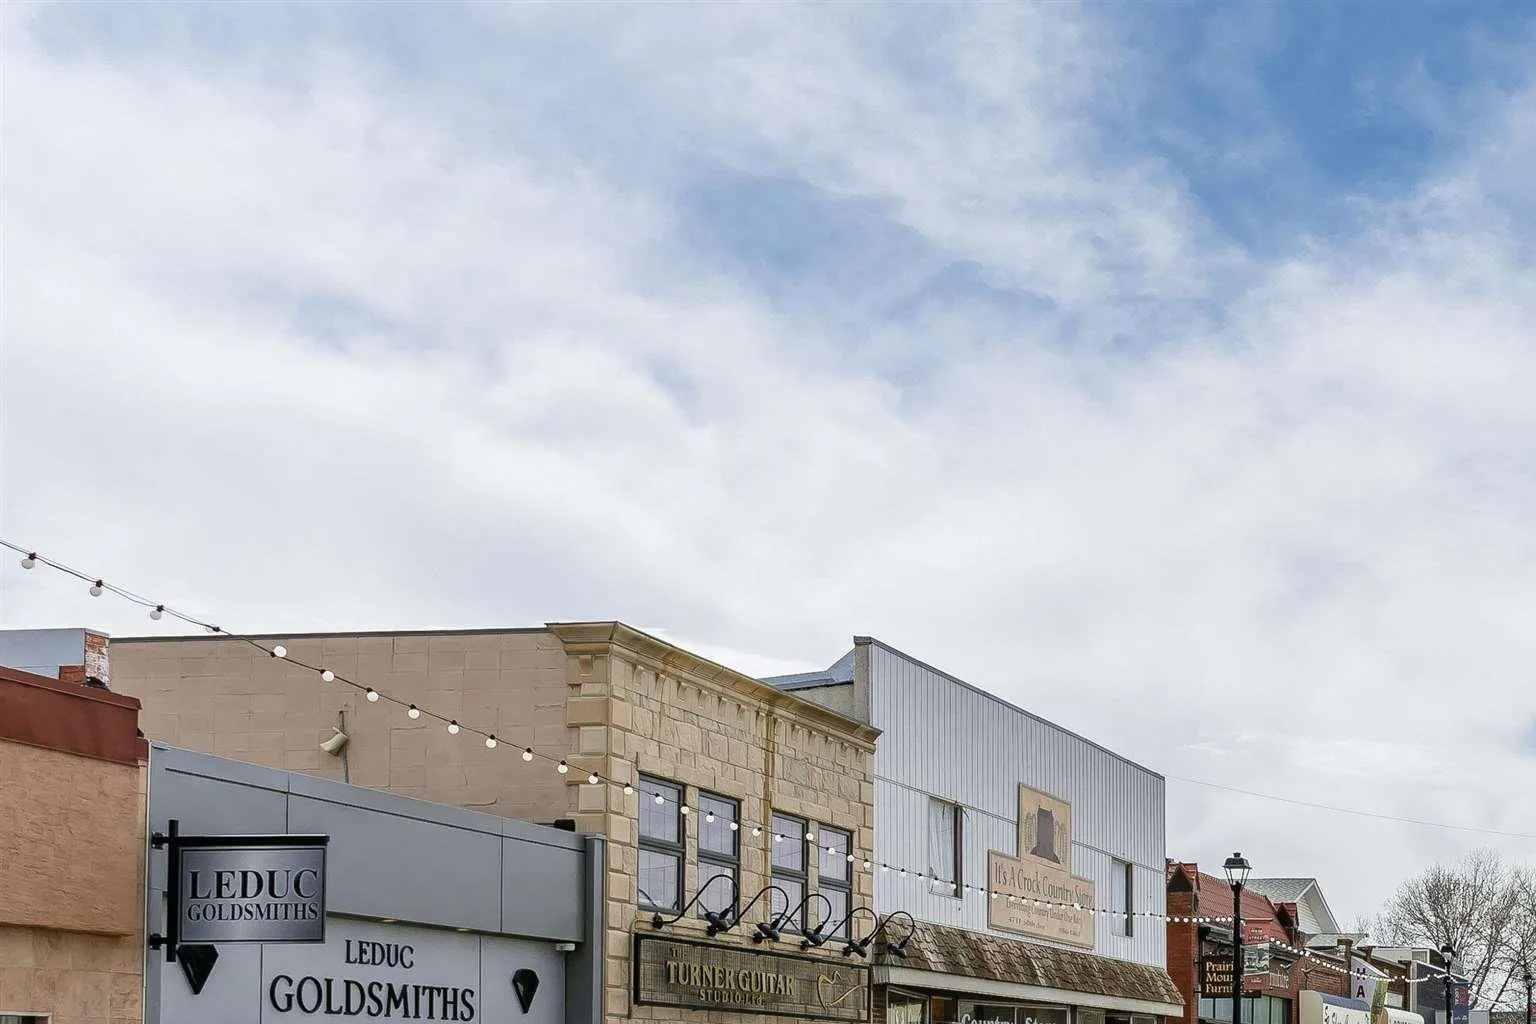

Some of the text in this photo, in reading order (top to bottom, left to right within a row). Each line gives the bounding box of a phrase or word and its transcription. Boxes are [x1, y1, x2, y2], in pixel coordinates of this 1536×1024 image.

[188, 868, 318, 900] LEDUC
[994, 861, 1007, 886] It's
[1009, 866, 1016, 888] A
[1017, 869, 1041, 896] Crock
[1042, 875, 1073, 903] Country
[187, 902, 319, 922] GOLDSMITHS
[344, 938, 414, 969] LEDUC
[1206, 960, 1234, 972] Prairi
[665, 960, 795, 996] TURNER GUITAR
[1206, 973, 1234, 982] Mou
[1206, 984, 1234, 993] Furni
[269, 974, 476, 1022] GOLDSMITHS
[699, 989, 741, 1004] STUDIO
